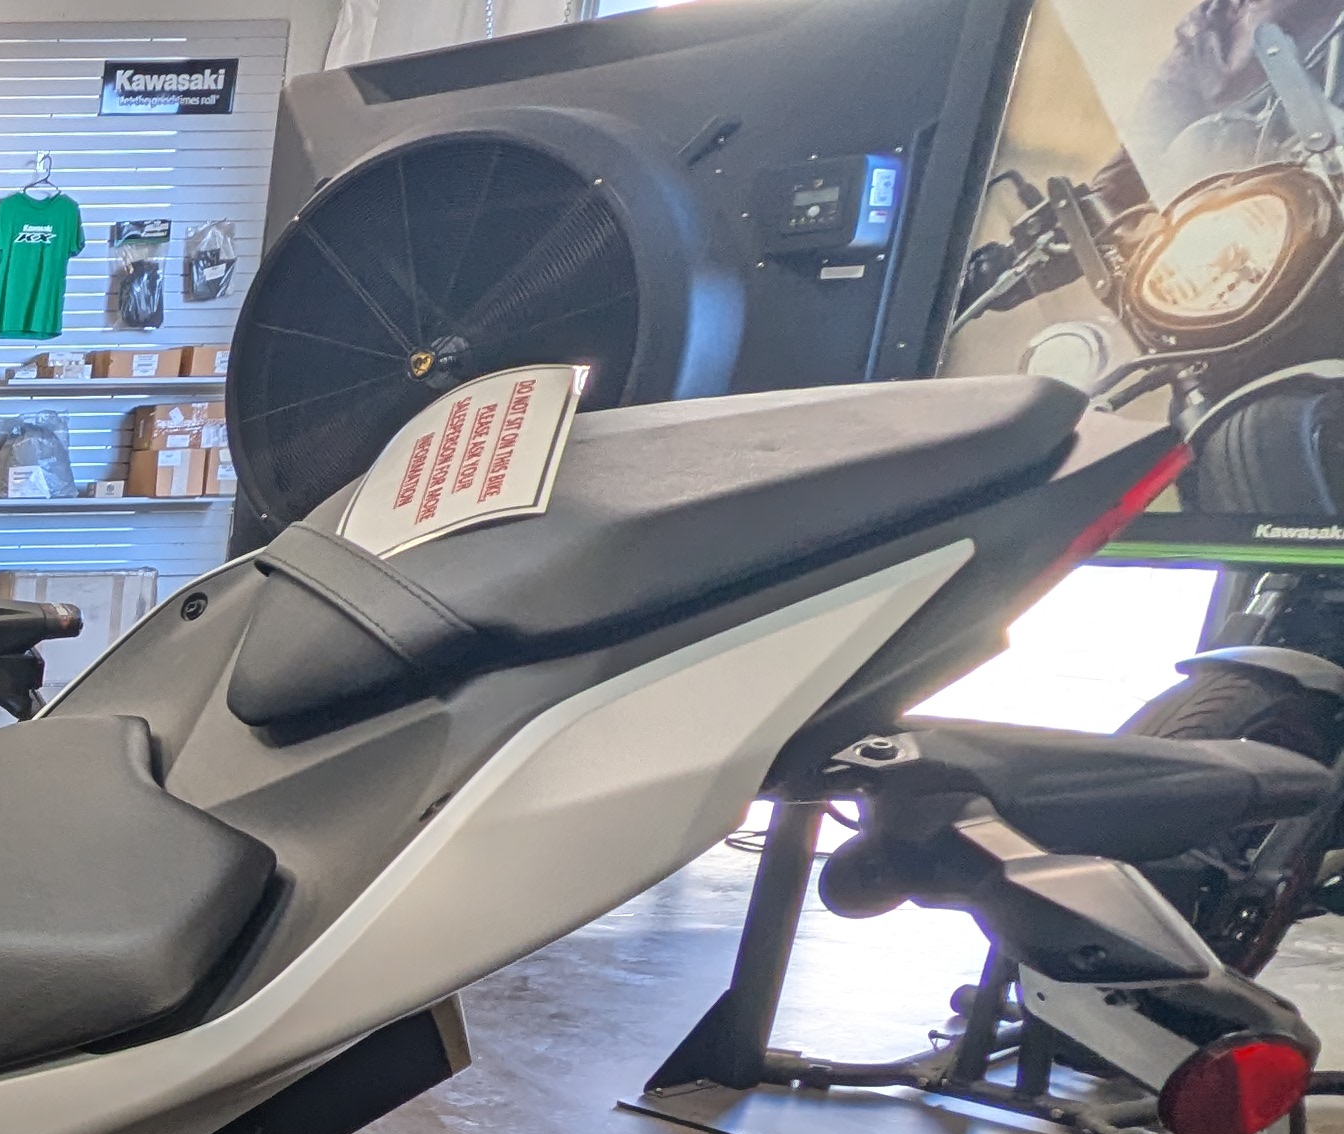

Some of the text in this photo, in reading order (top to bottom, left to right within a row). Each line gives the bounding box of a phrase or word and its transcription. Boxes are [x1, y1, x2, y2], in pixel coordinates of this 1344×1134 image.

[115, 69, 226, 92] Kawasaki
[517, 379, 537, 395] DO
[509, 394, 531, 415] NOT
[503, 416, 524, 431] SIT
[458, 403, 498, 492] PLEASE ASK YOUR
[498, 433, 519, 449] ON
[397, 432, 435, 507] INFORMATION
[419, 396, 472, 522] SALESPERSON FOR MORE
[490, 449, 514, 474] THIS
[1255, 524, 1344, 539] Kawasak
